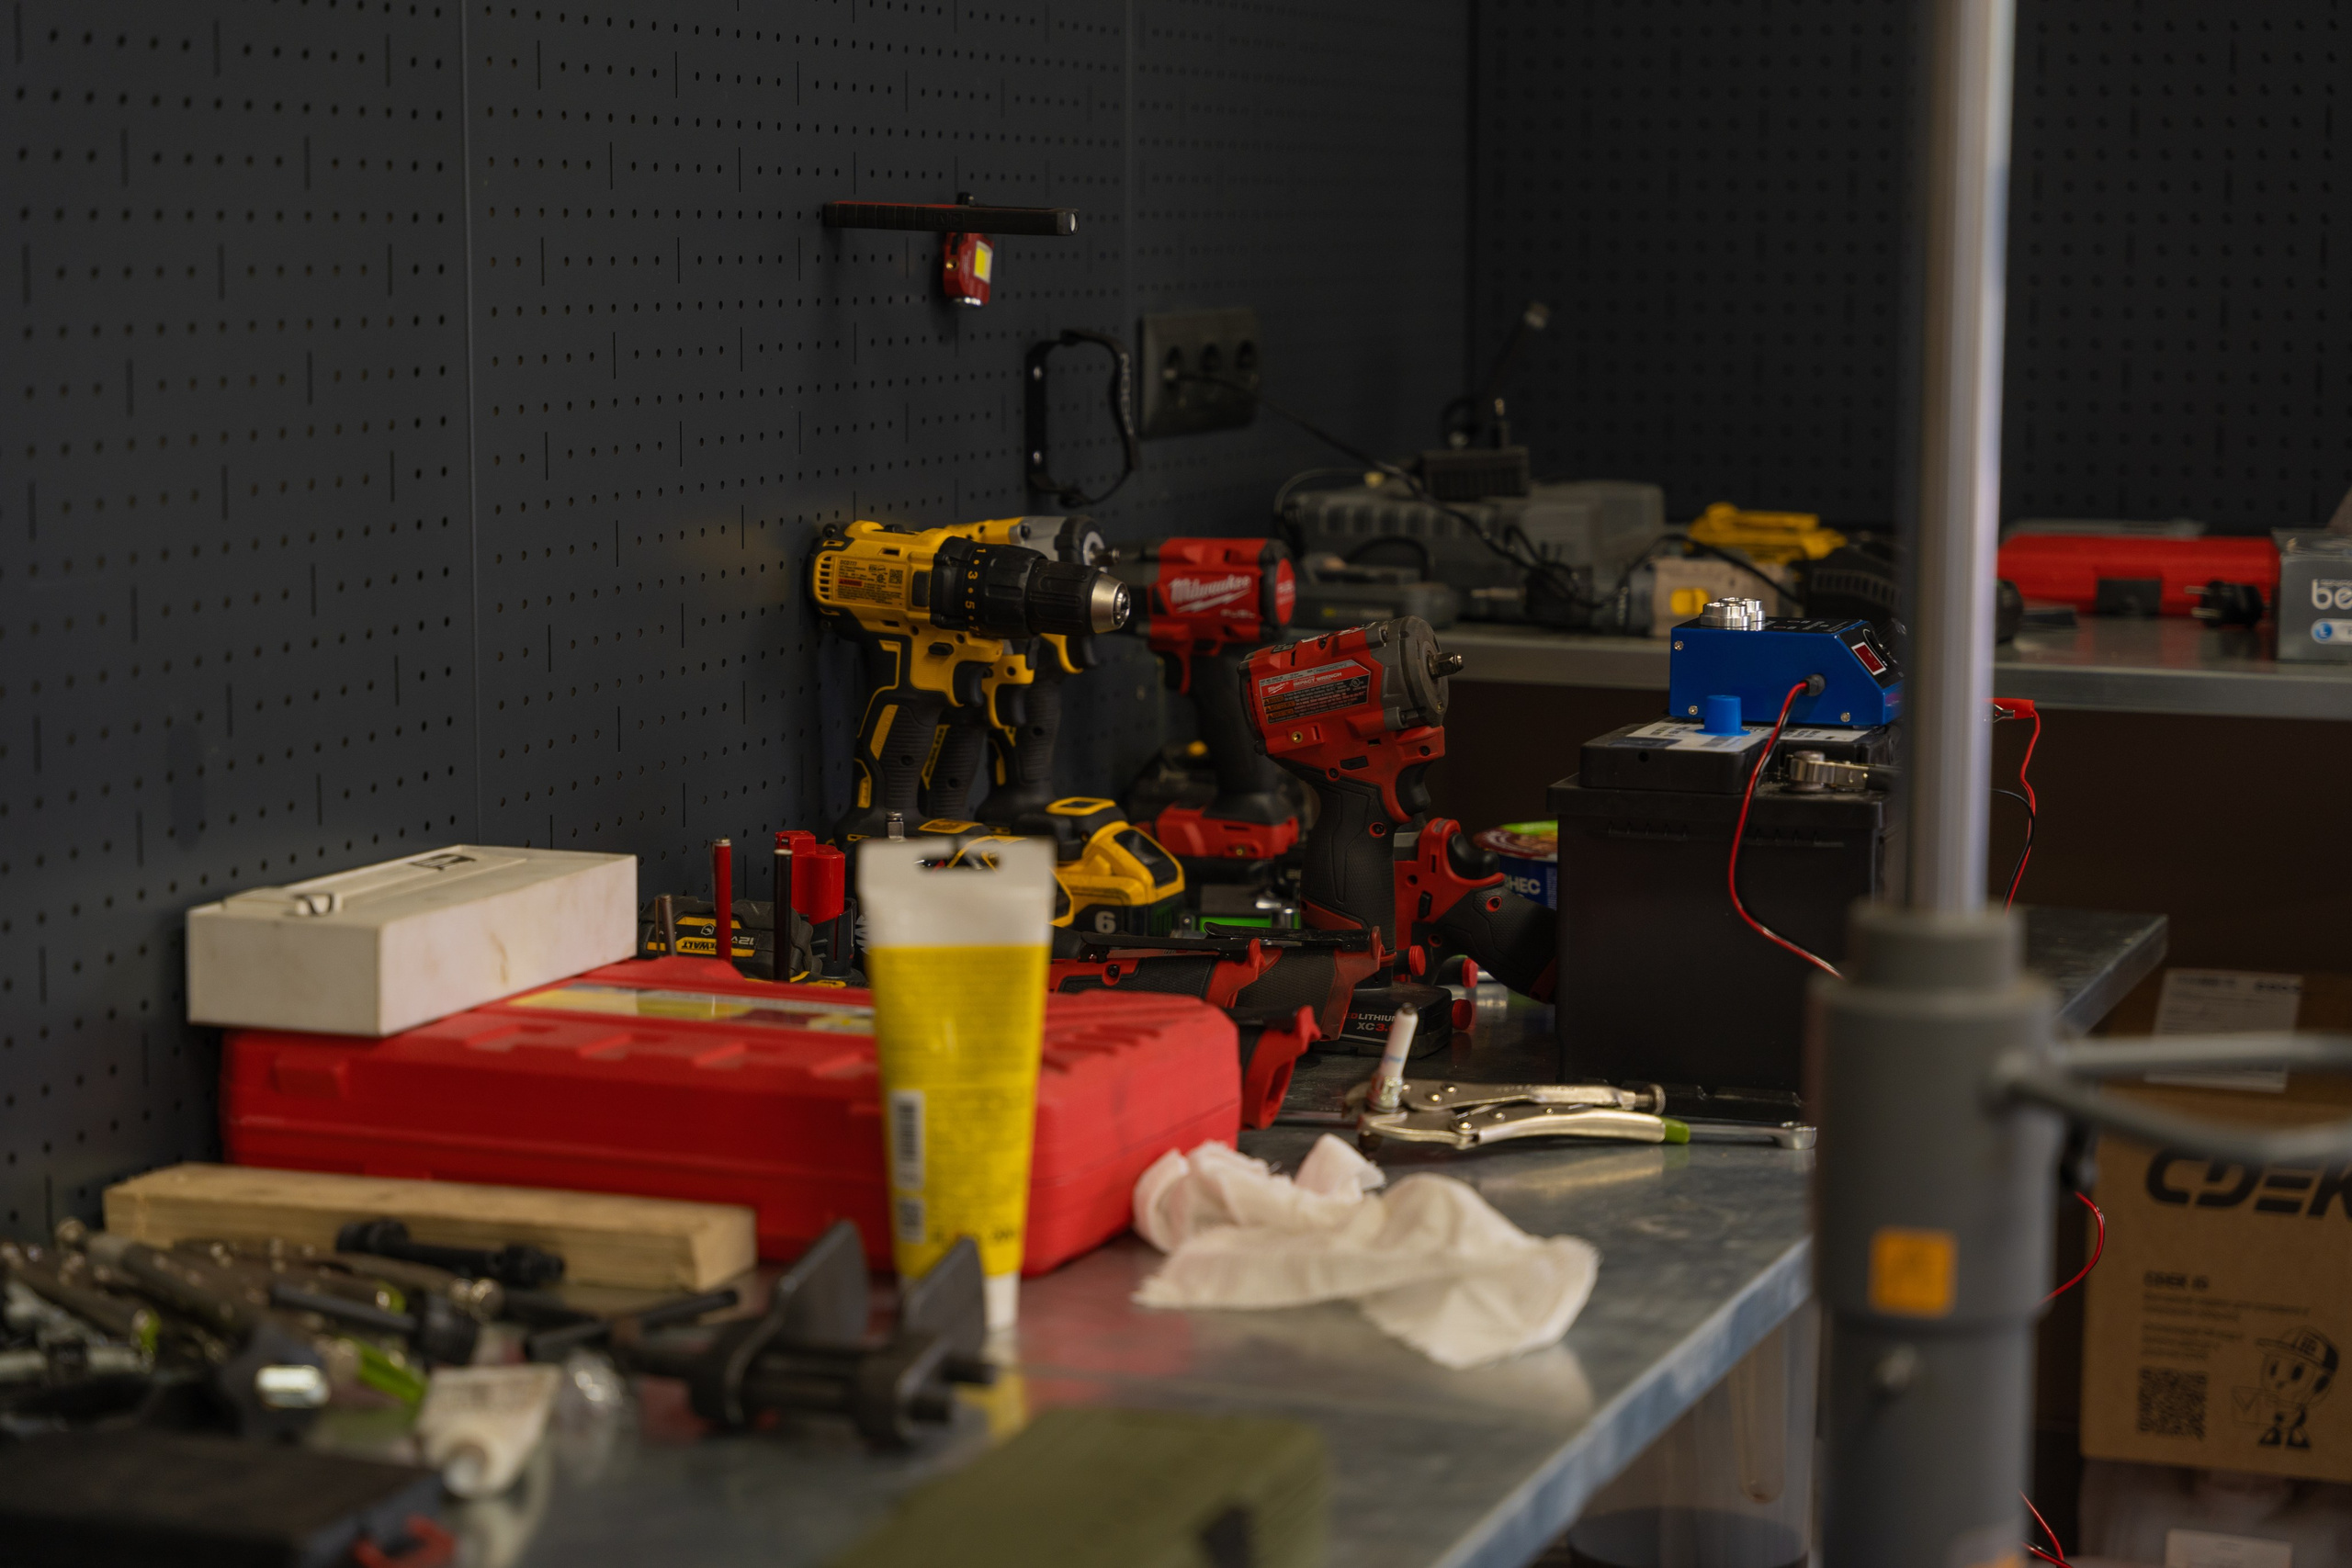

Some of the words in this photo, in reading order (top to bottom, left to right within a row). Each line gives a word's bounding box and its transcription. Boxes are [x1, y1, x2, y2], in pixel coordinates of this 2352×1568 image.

[967, 570, 978, 580] 3
[965, 601, 976, 610] 5
[1294, 678, 1316, 686] IMPACT
[1317, 671, 1342, 682] WRENCH
[1095, 910, 1116, 934] 6
[682, 941, 717, 951] EWALT
